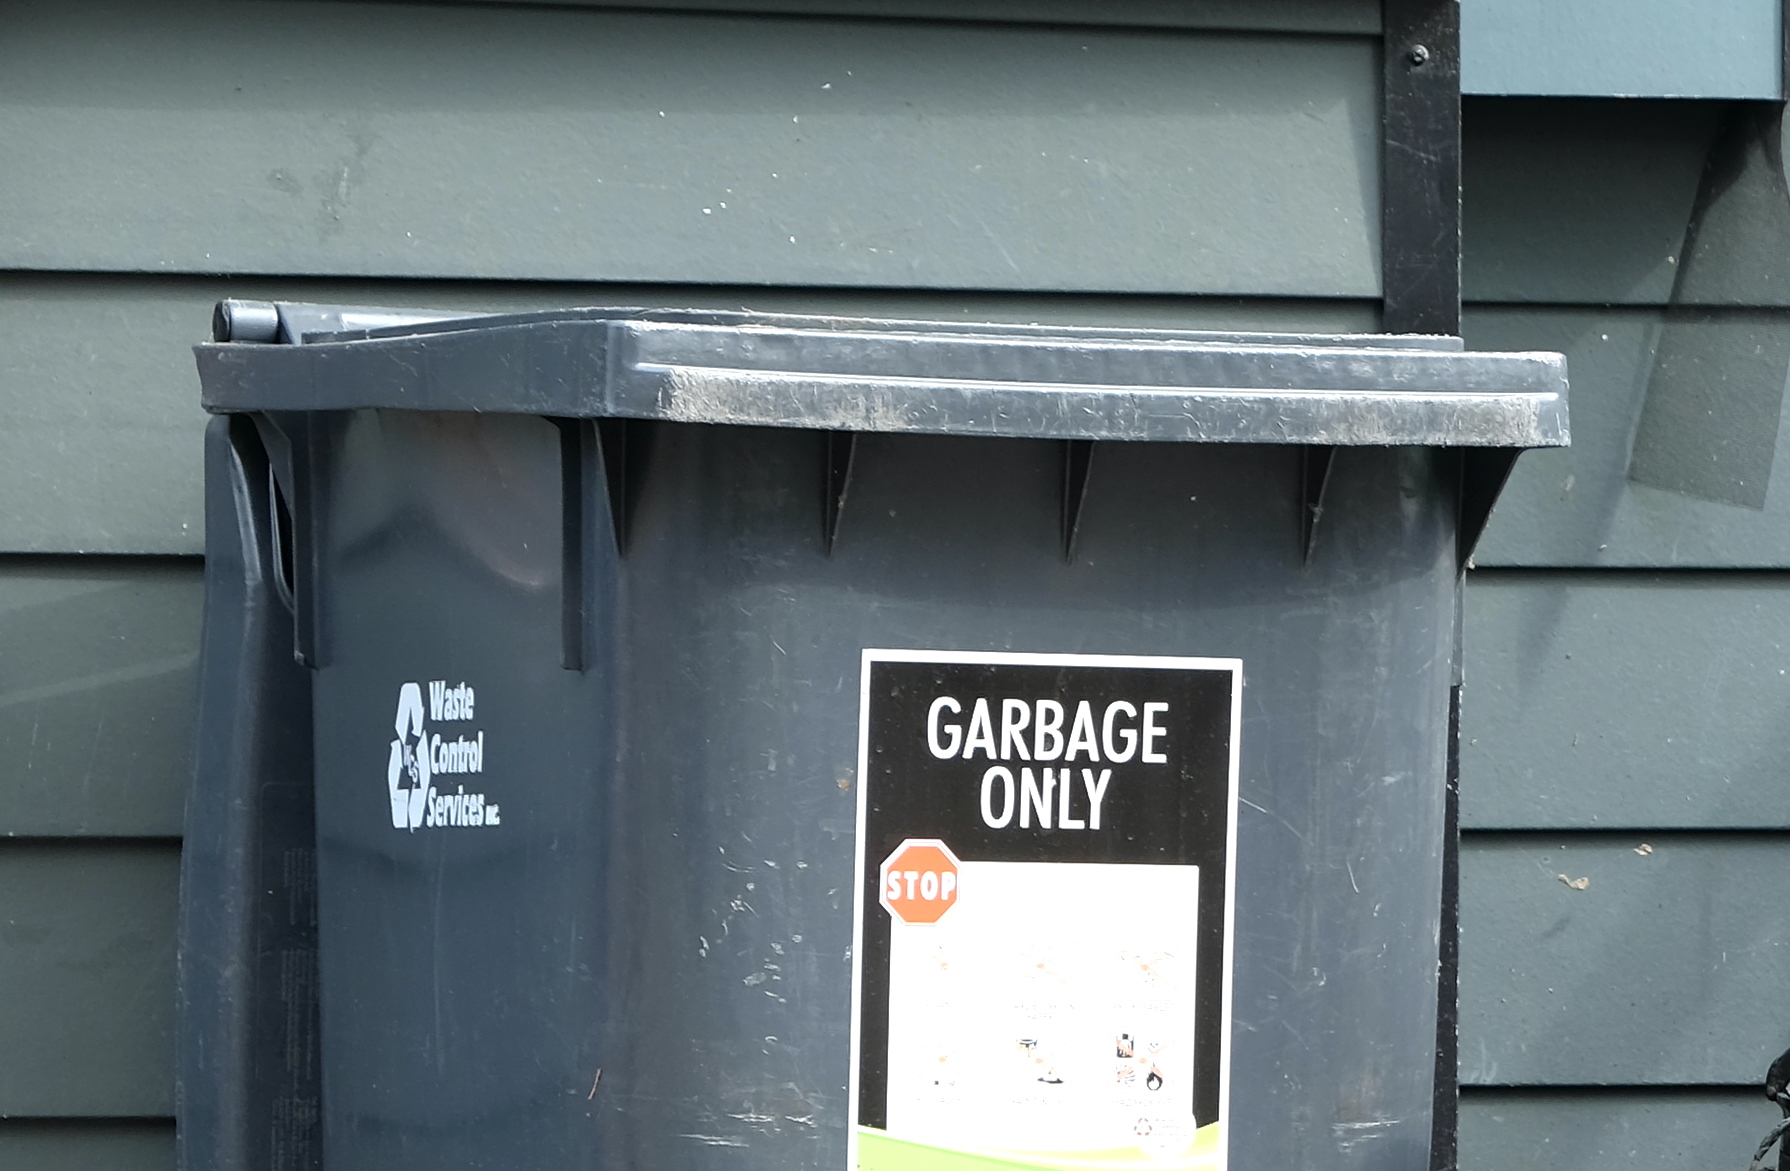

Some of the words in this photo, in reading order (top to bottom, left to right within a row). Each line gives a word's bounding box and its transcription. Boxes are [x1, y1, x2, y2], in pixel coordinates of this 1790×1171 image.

[429, 680, 474, 721] Waste
[927, 696, 1169, 764] GARBAGE
[430, 730, 483, 775] Control
[426, 784, 485, 828] Services
[980, 765, 1112, 831] ONLY
[887, 870, 957, 901] STOP
